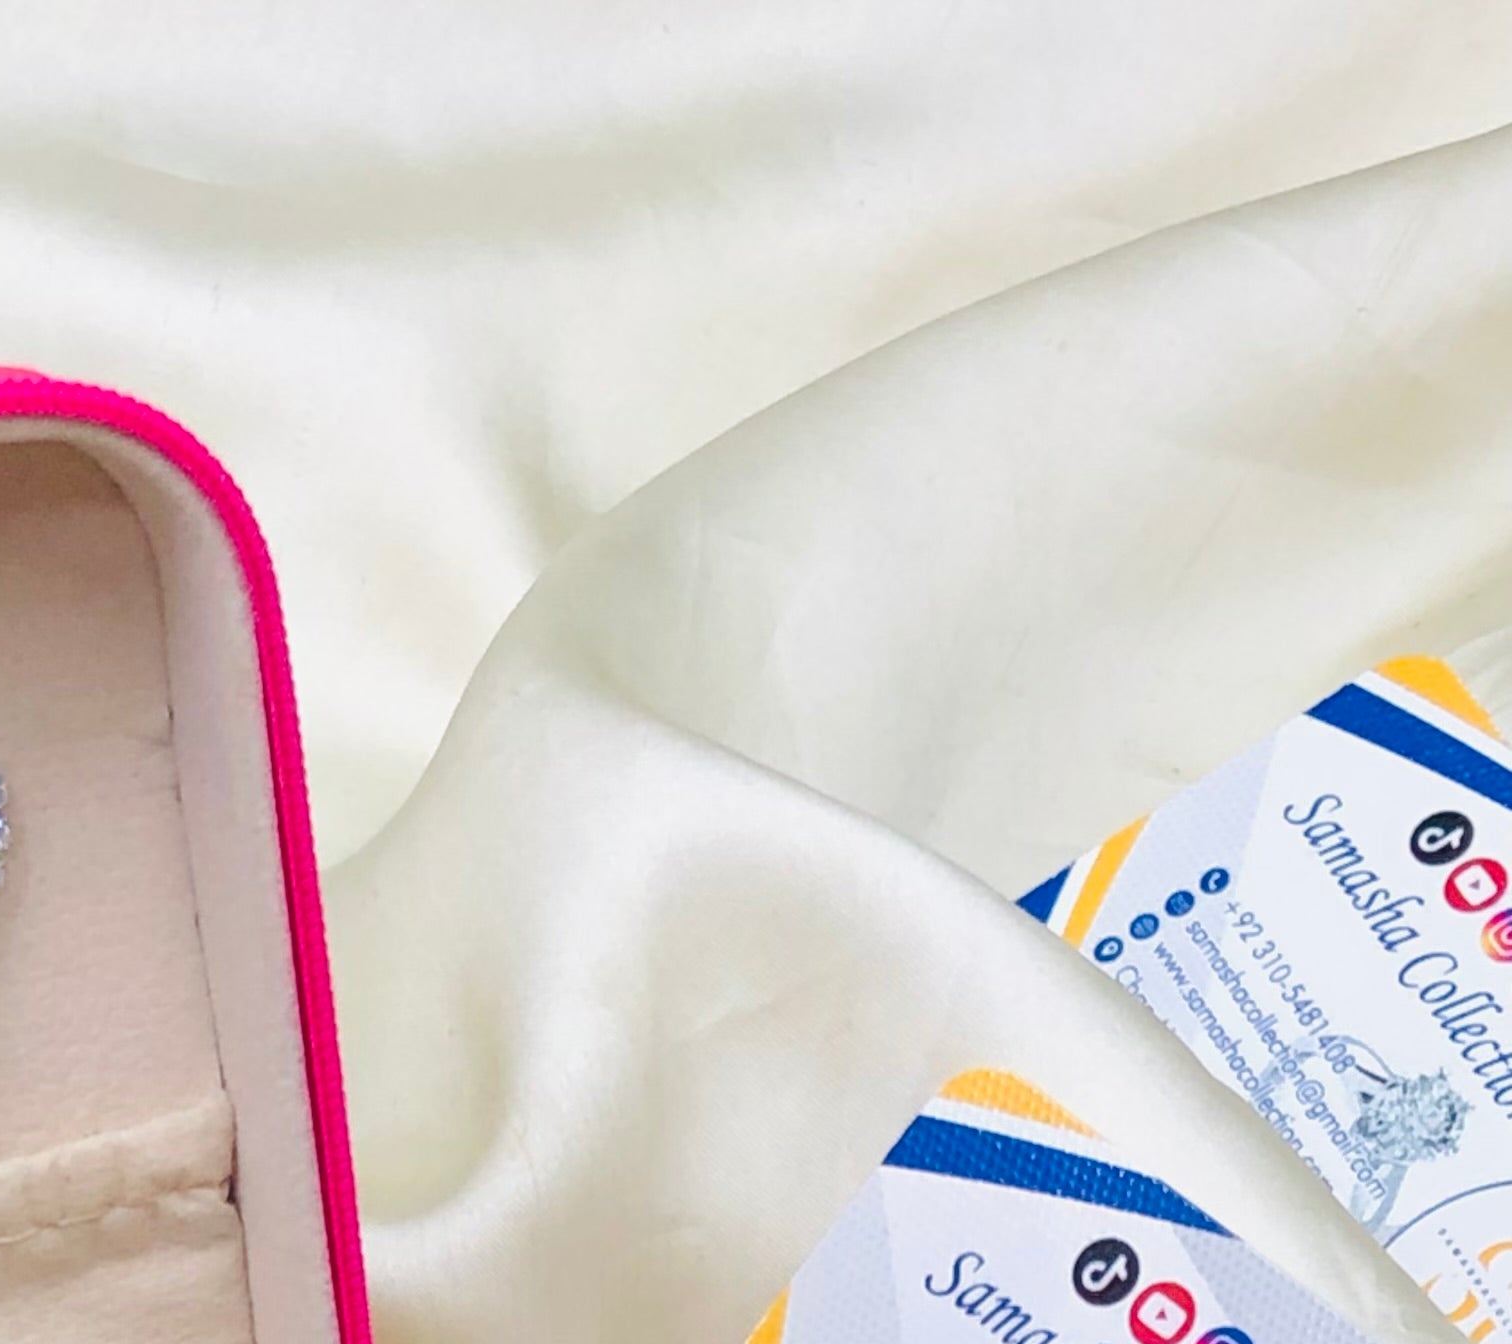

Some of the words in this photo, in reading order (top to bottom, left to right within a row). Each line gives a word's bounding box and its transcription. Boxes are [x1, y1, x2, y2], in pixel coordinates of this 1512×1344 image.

[1185, 920, 1386, 1199] samashacollection@gmail.com
[1227, 903, 1263, 942] +92
[1253, 941, 1357, 1073] 310-5481408
[1284, 795, 1424, 952] Samasha
[1398, 953, 1512, 1119] Collecti
